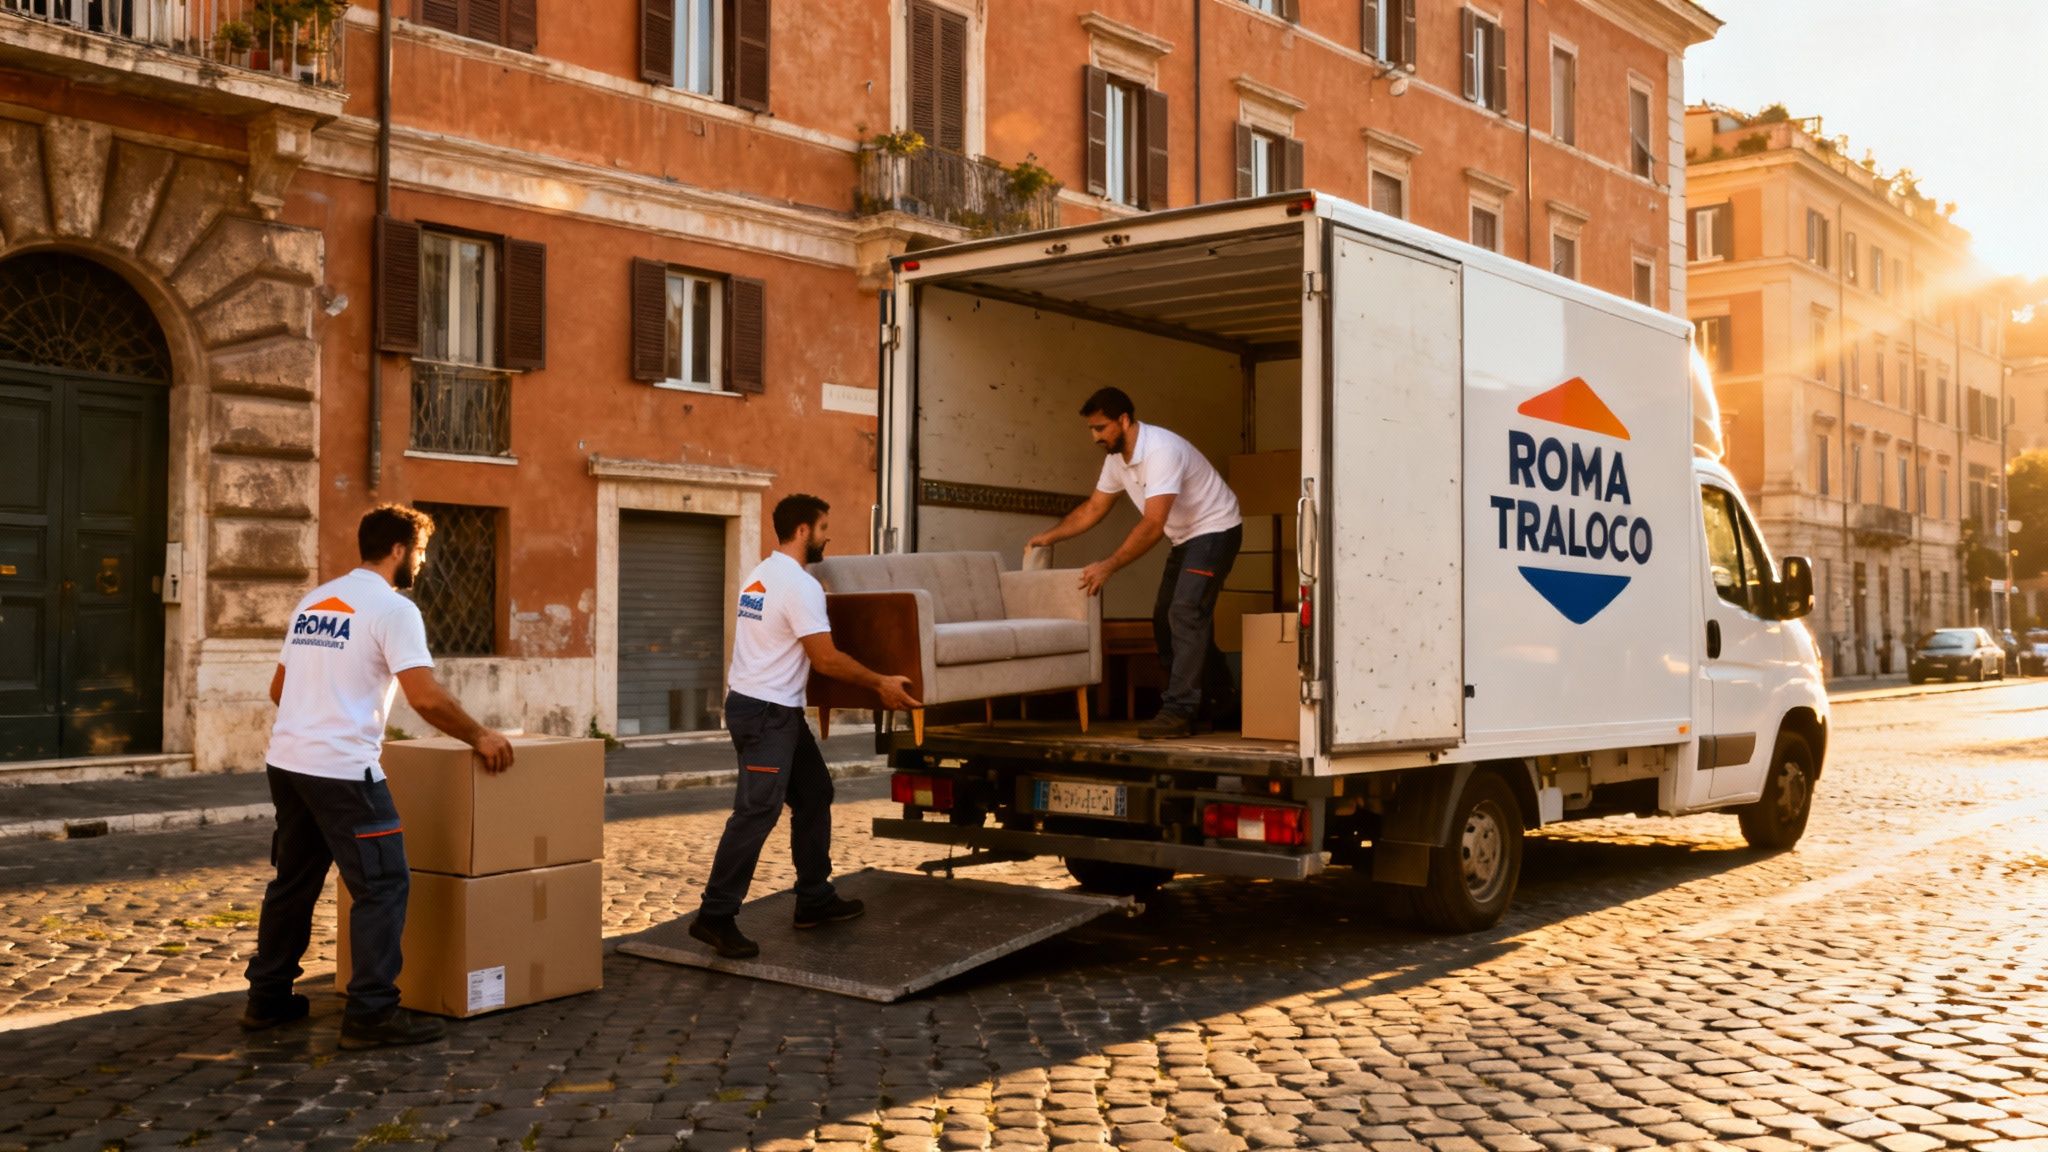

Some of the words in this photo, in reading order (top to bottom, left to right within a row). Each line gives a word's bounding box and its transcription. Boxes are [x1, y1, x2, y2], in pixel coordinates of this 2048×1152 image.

[1509, 429, 1631, 505] ROMA
[1490, 495, 1652, 565] TRALOCO
[294, 613, 350, 641] ROMA
